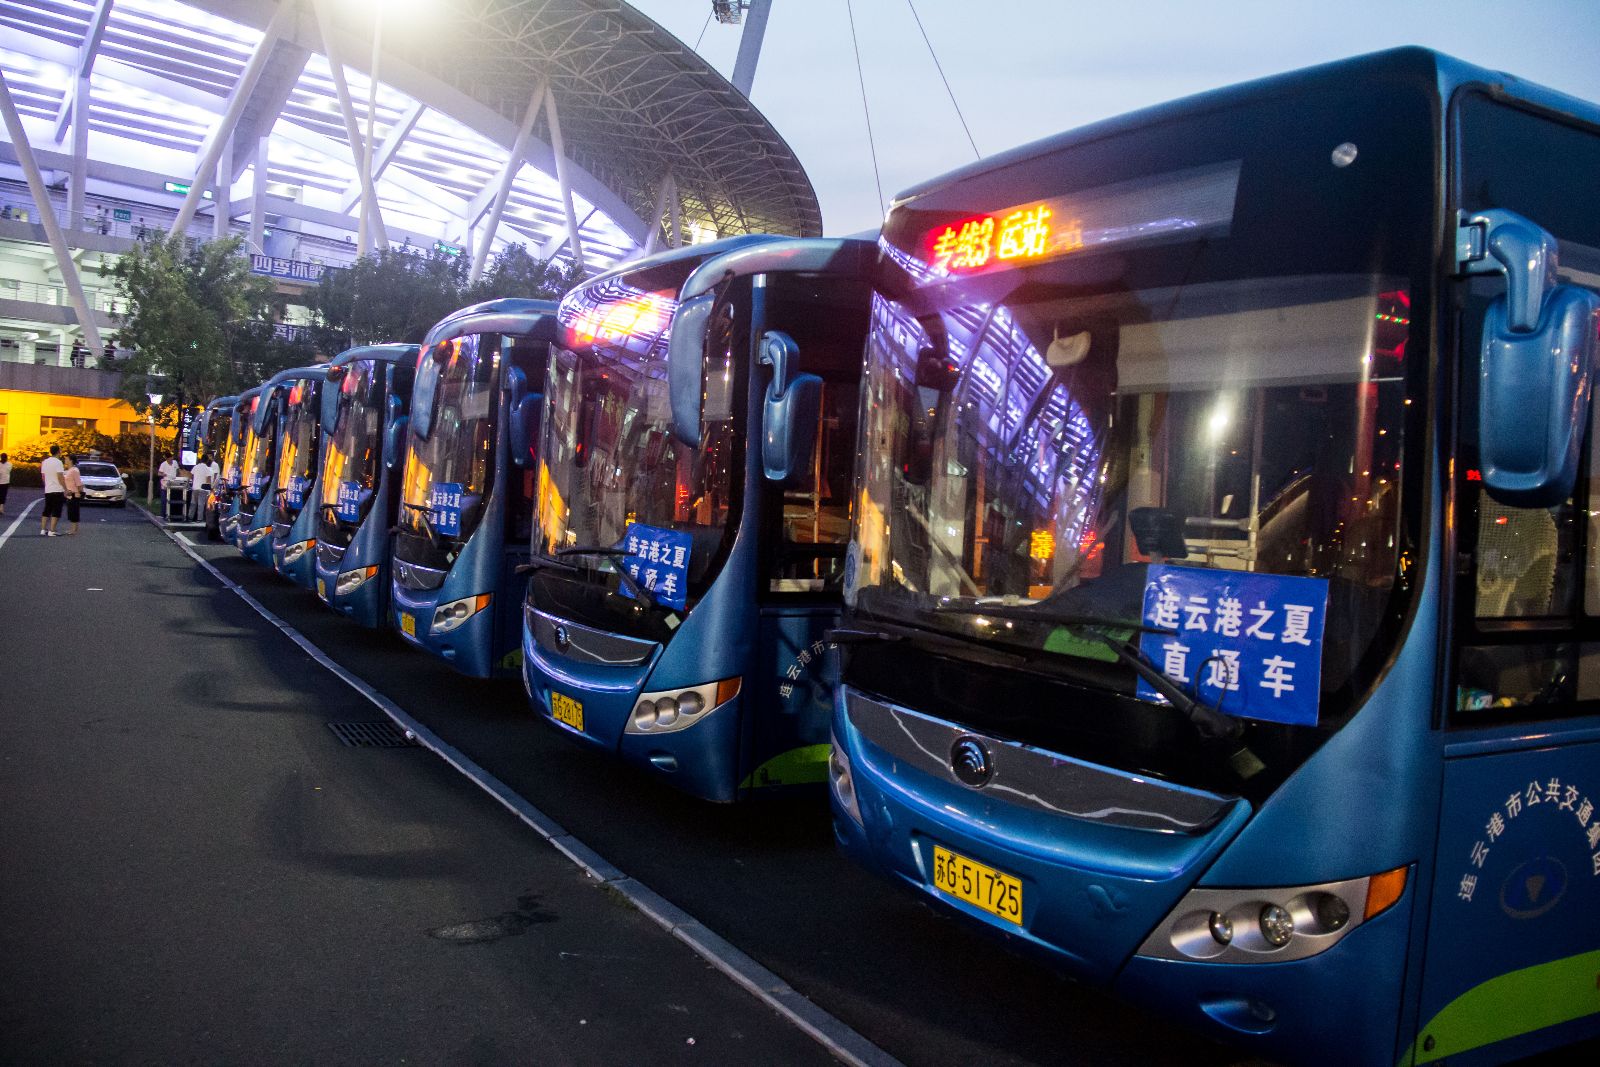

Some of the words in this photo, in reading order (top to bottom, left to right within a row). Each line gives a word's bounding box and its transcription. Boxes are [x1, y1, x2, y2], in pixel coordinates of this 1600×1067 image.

[628, 536, 687, 569] 连云港之夏
[1153, 589, 1315, 647] 连云港之夏
[1161, 641, 1297, 699] 直通车
